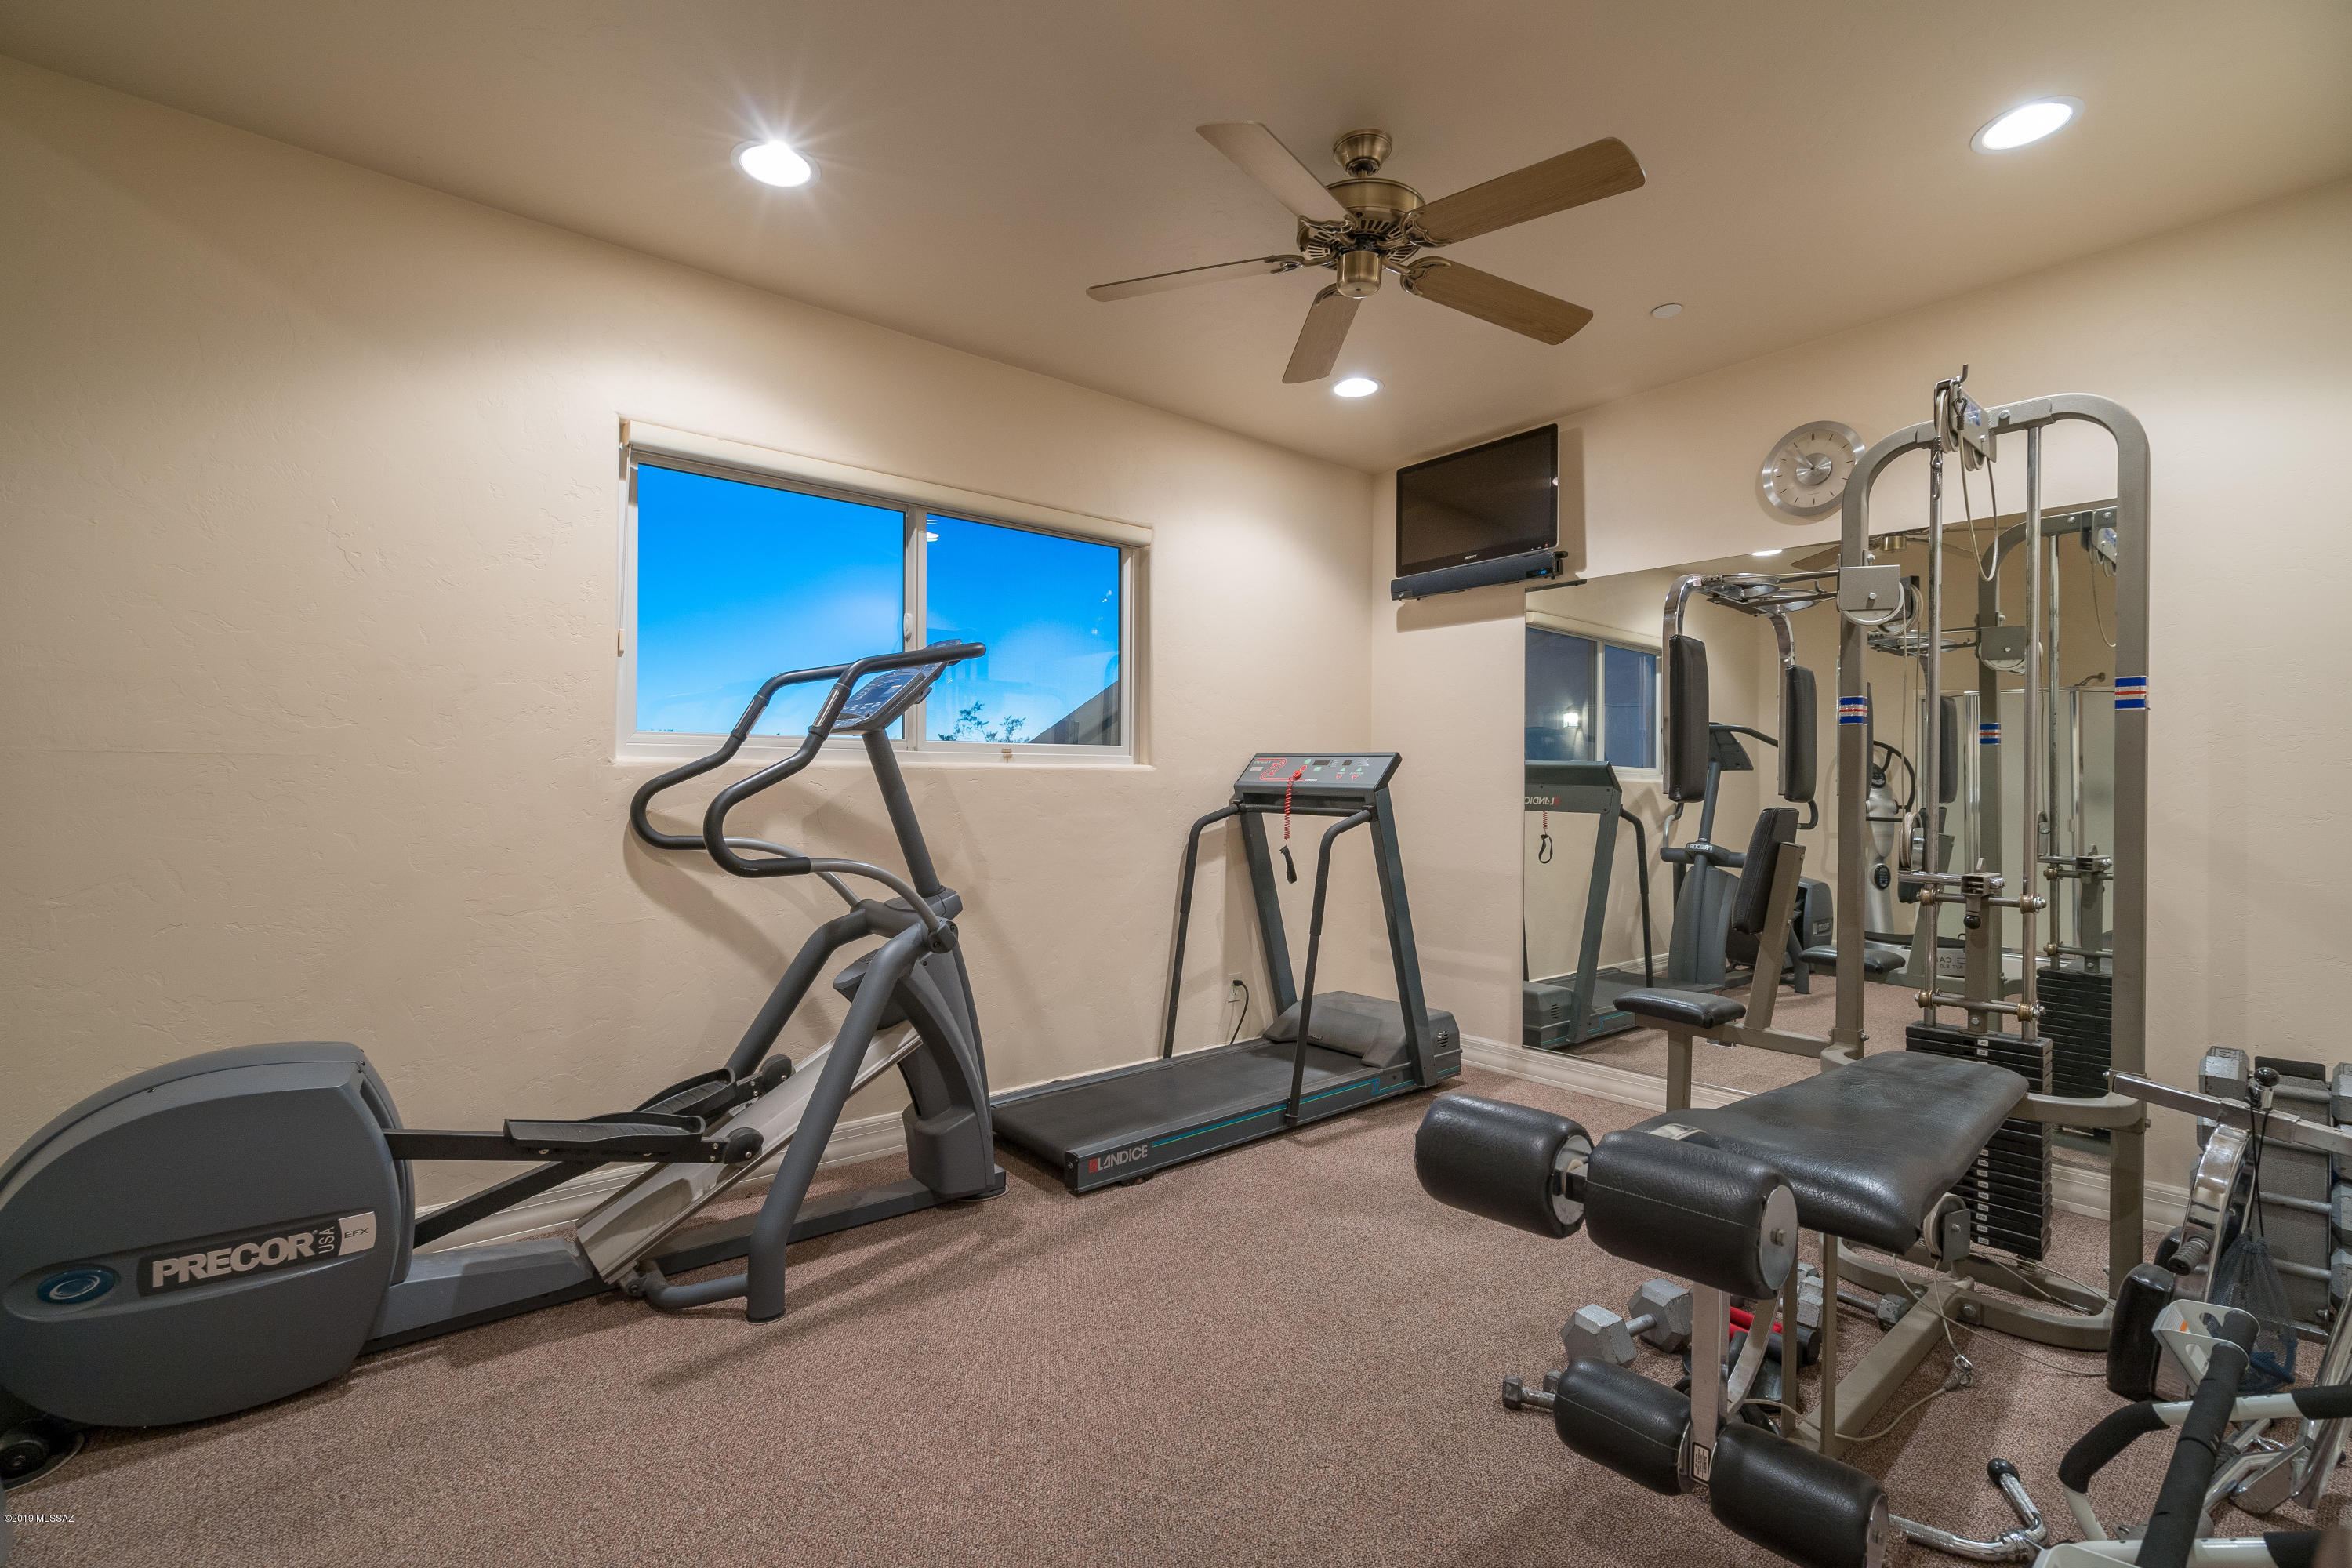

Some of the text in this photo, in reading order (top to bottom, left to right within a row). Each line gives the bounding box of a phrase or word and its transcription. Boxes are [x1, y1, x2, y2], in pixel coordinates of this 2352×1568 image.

[1098, 1145, 1148, 1171] LANDICE
[344, 1228, 369, 1239] EFX
[152, 1226, 335, 1288] PRECOR USA
